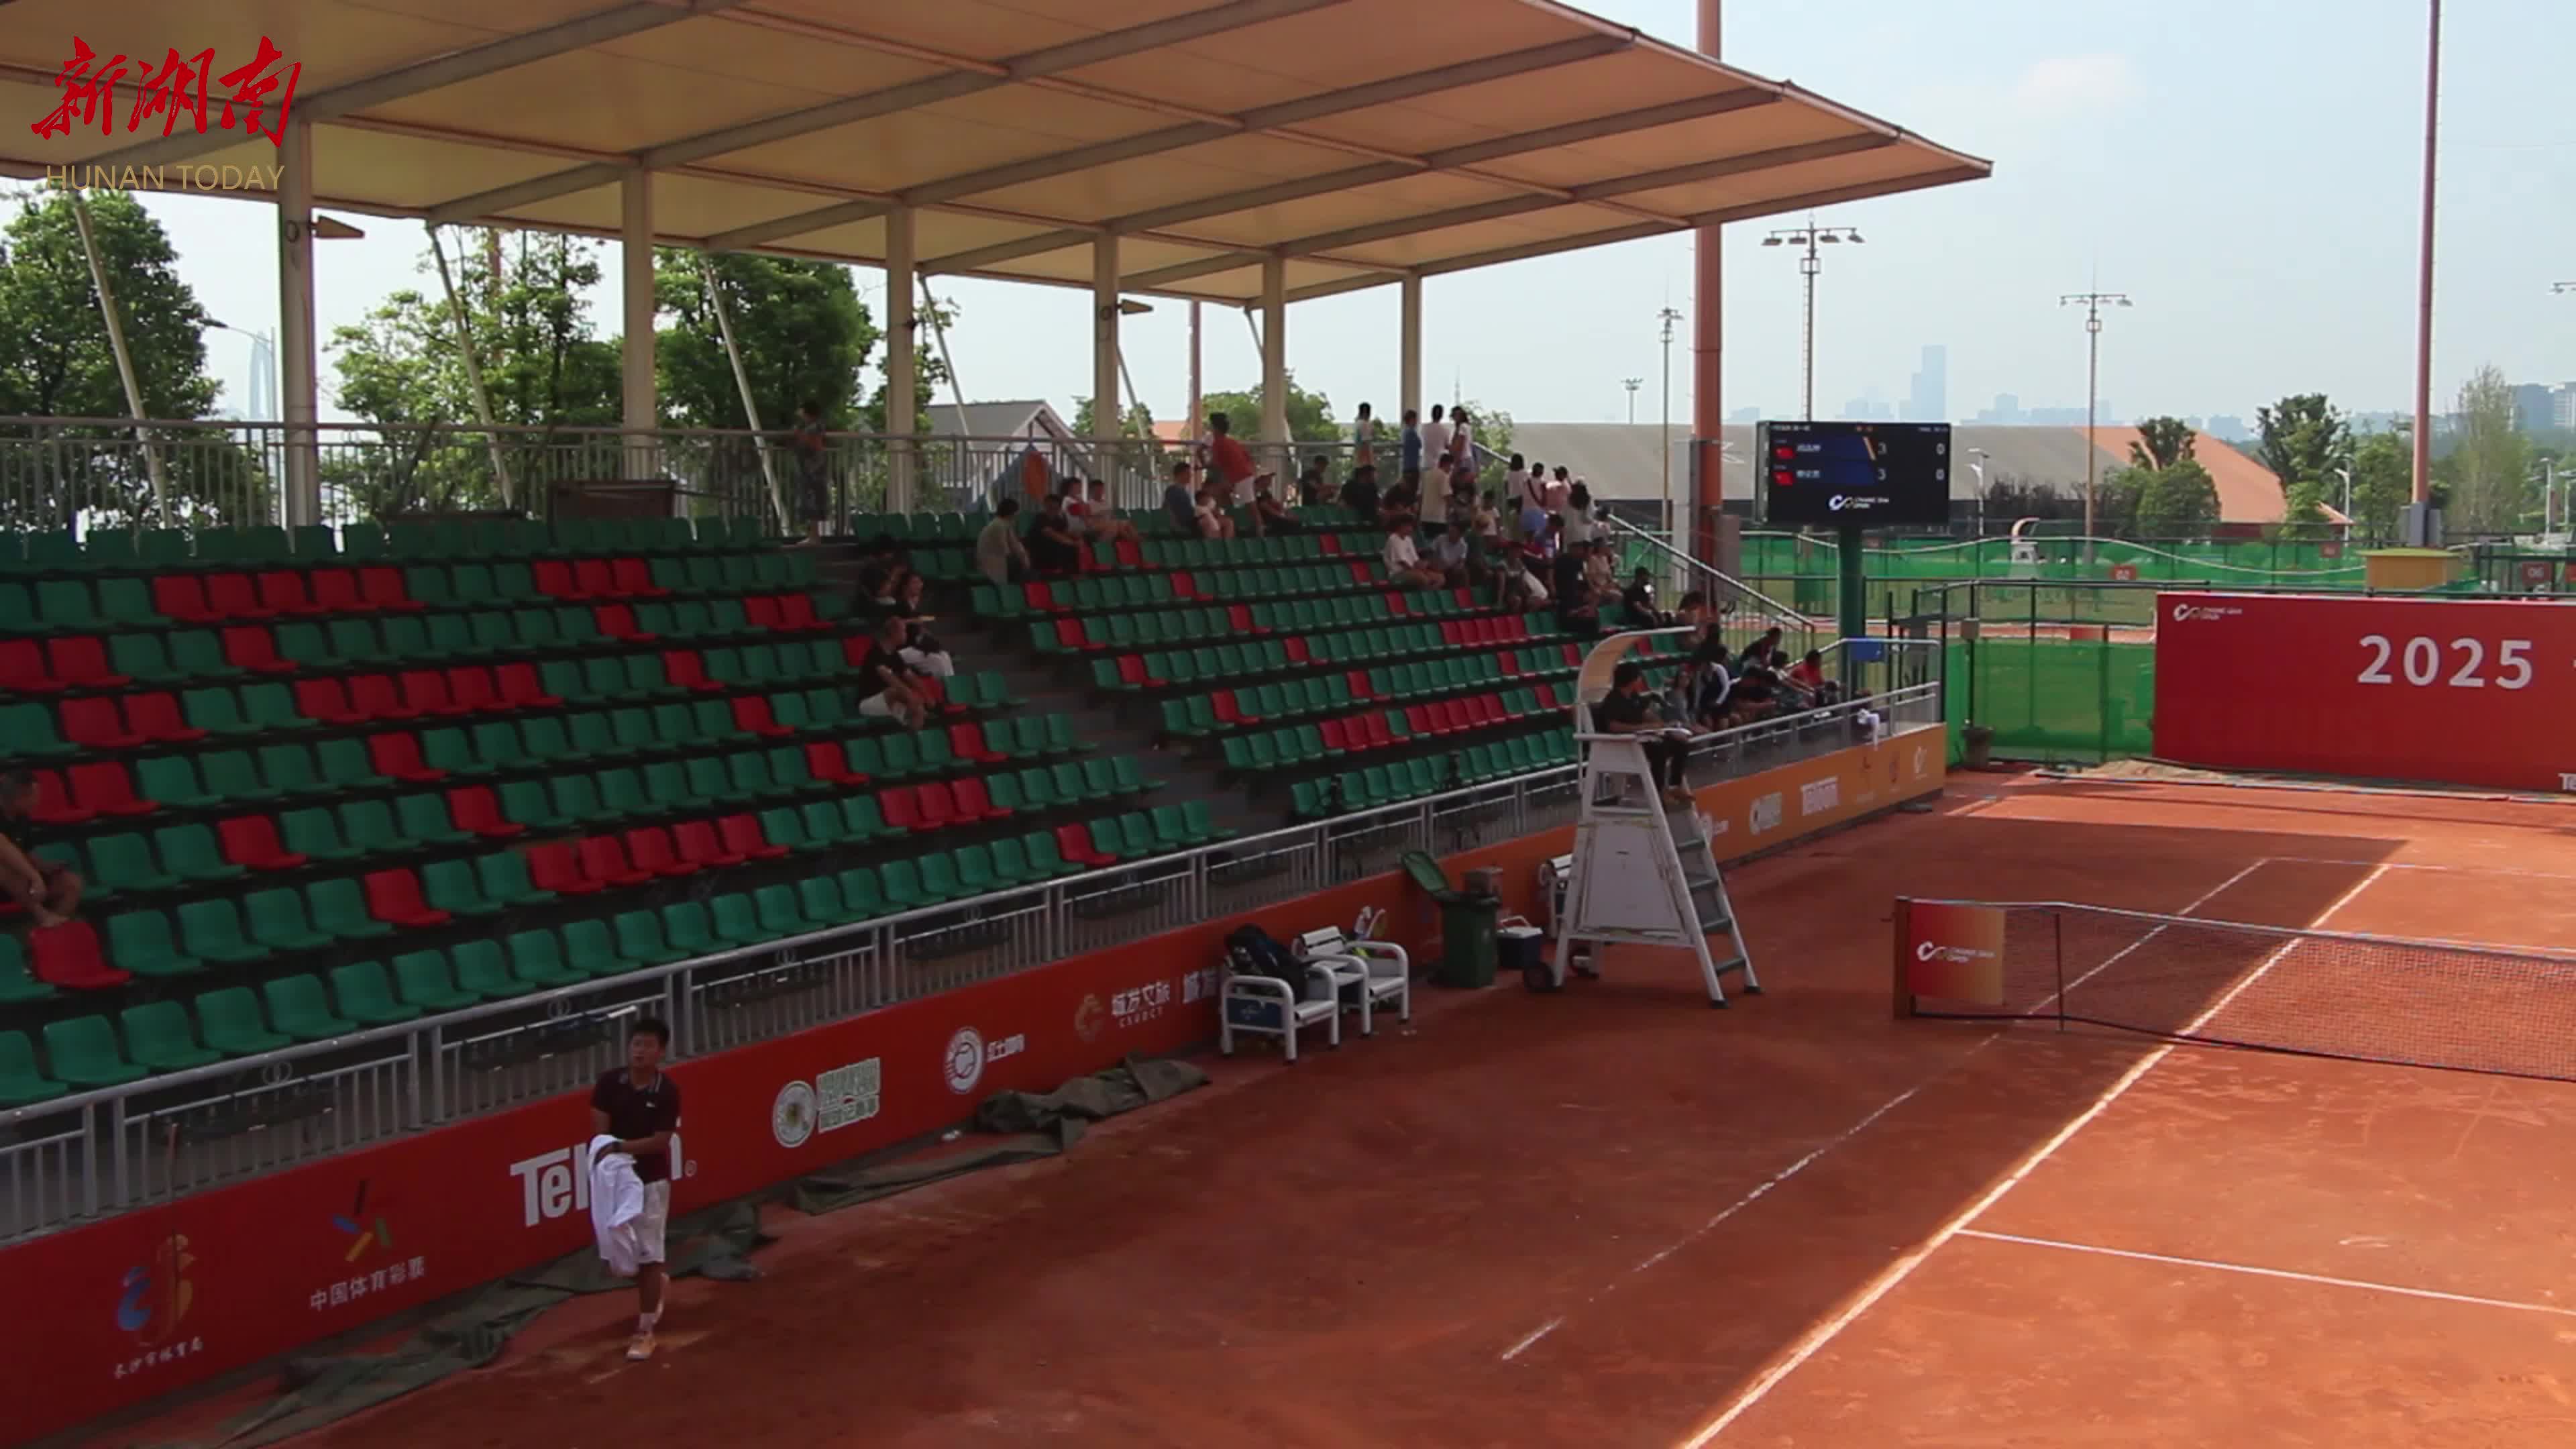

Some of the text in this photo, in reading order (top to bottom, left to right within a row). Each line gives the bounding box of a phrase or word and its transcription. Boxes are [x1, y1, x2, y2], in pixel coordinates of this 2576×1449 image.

[2357, 635, 2533, 690] 2025
[309, 1255, 425, 1311] 中国体育彩票
